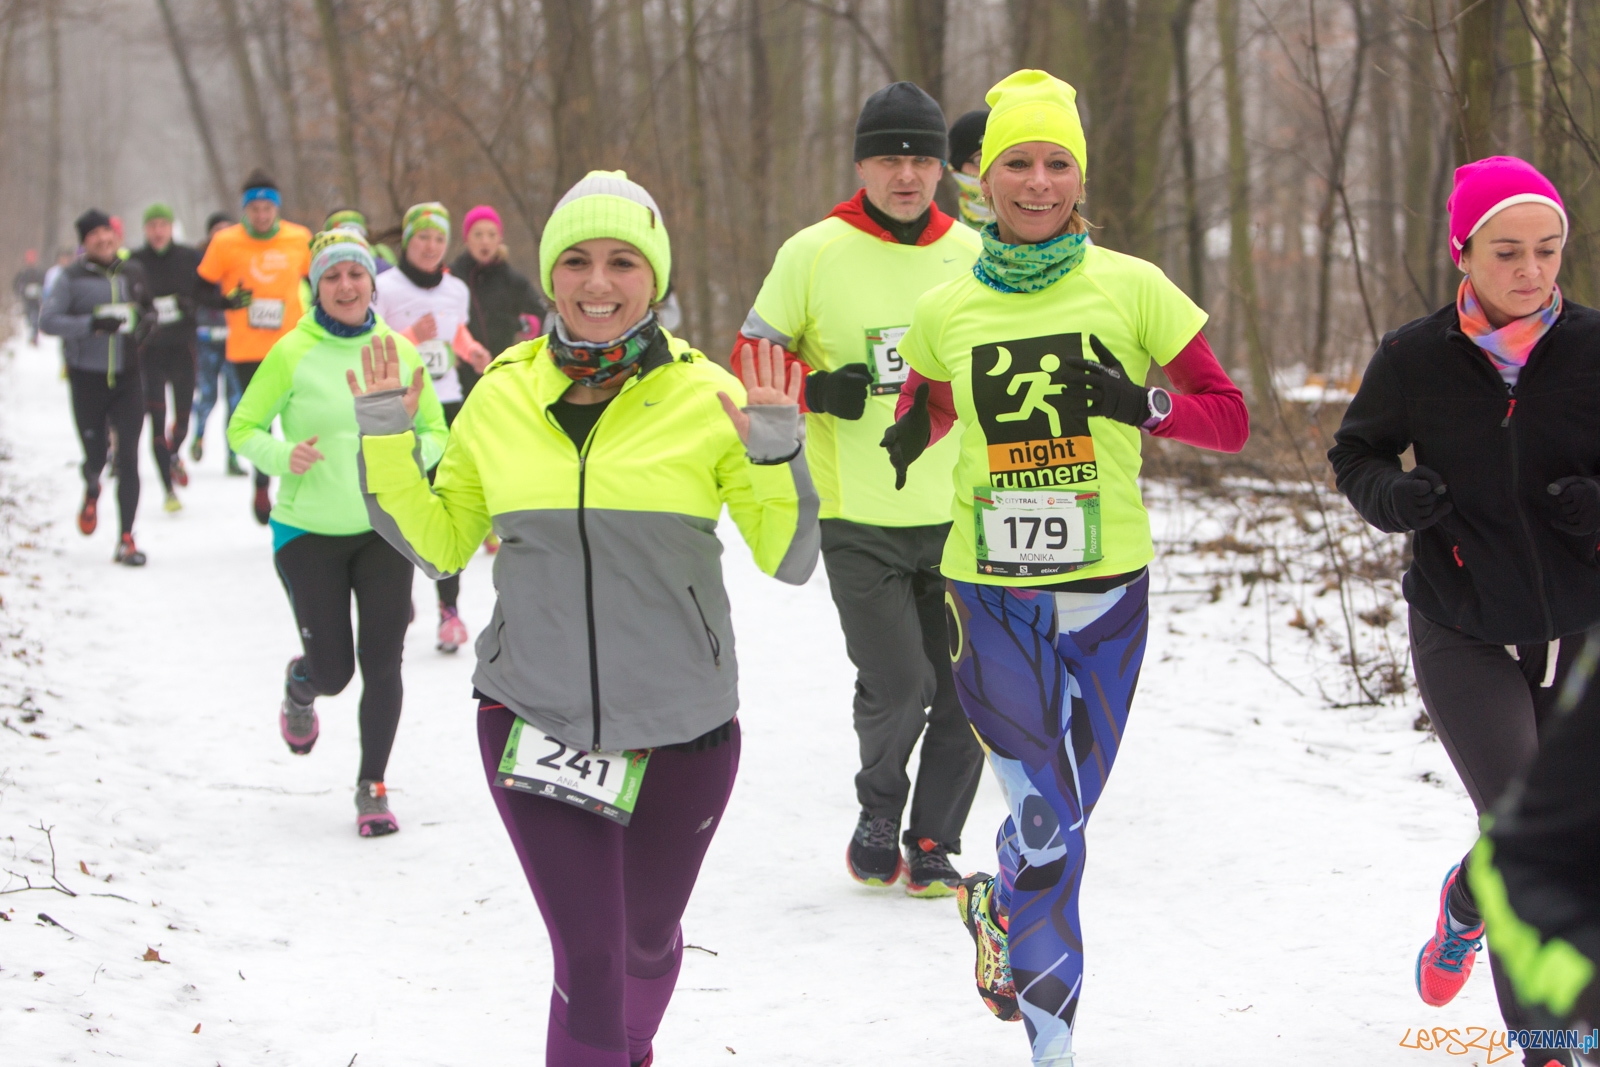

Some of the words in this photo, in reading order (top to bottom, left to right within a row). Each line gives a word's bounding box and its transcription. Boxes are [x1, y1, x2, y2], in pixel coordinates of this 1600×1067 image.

[1009, 439, 1076, 467] night
[991, 463, 1097, 488] runners
[1003, 516, 1068, 550] 179
[1019, 553, 1055, 562] MONIKA
[536, 735, 610, 787] 241
[556, 775, 579, 789] ANIA
